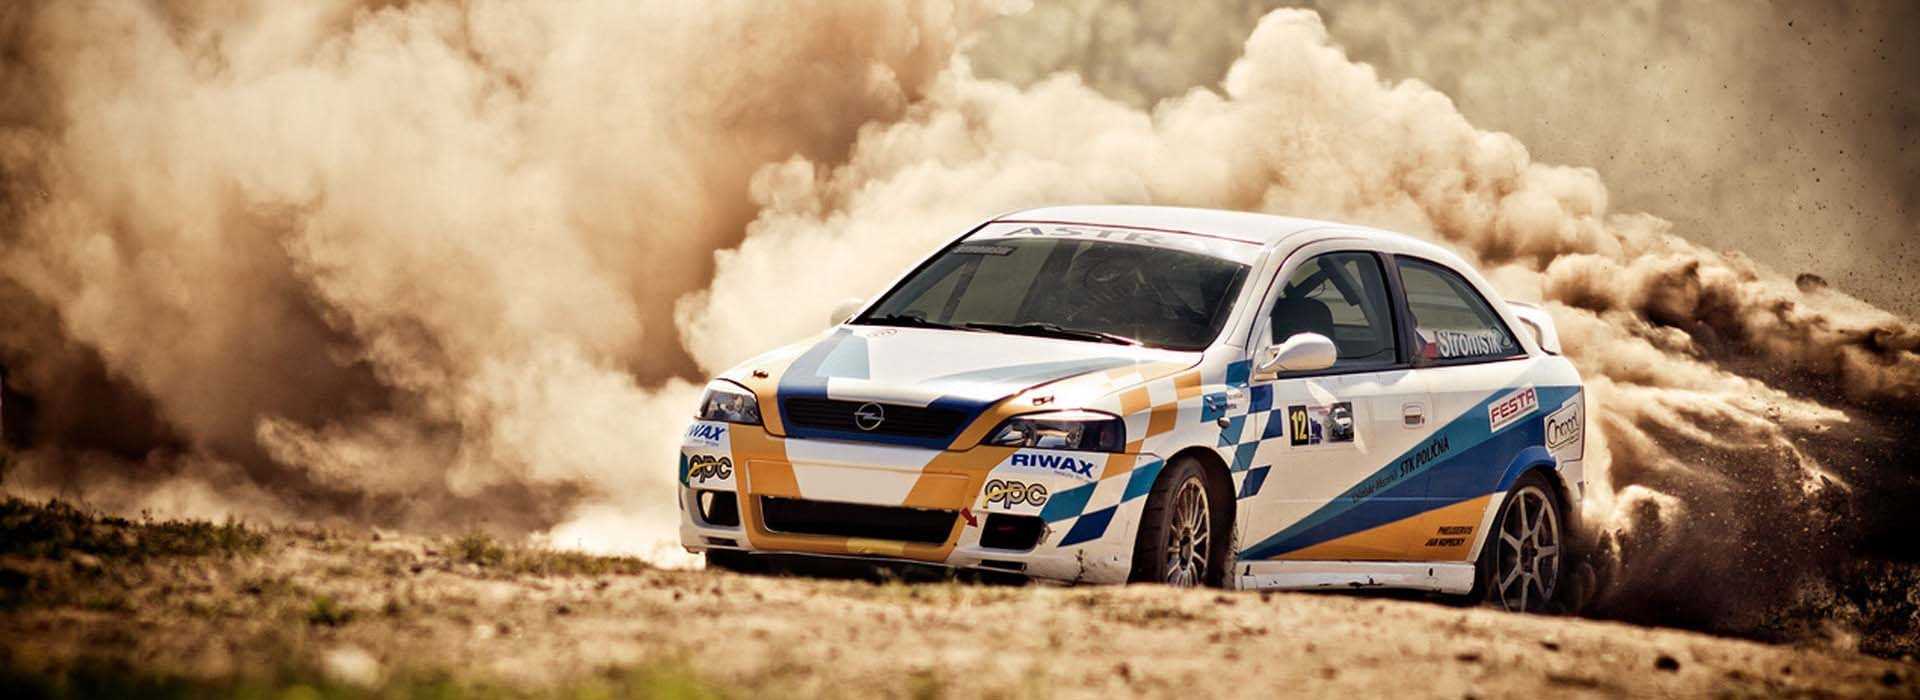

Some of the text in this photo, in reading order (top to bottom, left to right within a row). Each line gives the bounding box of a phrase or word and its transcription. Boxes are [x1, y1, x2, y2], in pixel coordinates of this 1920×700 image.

[1003, 226, 1162, 244] ASTR
[1491, 388, 1536, 423] FESTA
[689, 424, 725, 441] WAX
[1291, 410, 1308, 441] 12
[1011, 454, 1094, 479] RIWAX
[985, 479, 1048, 509] opc
